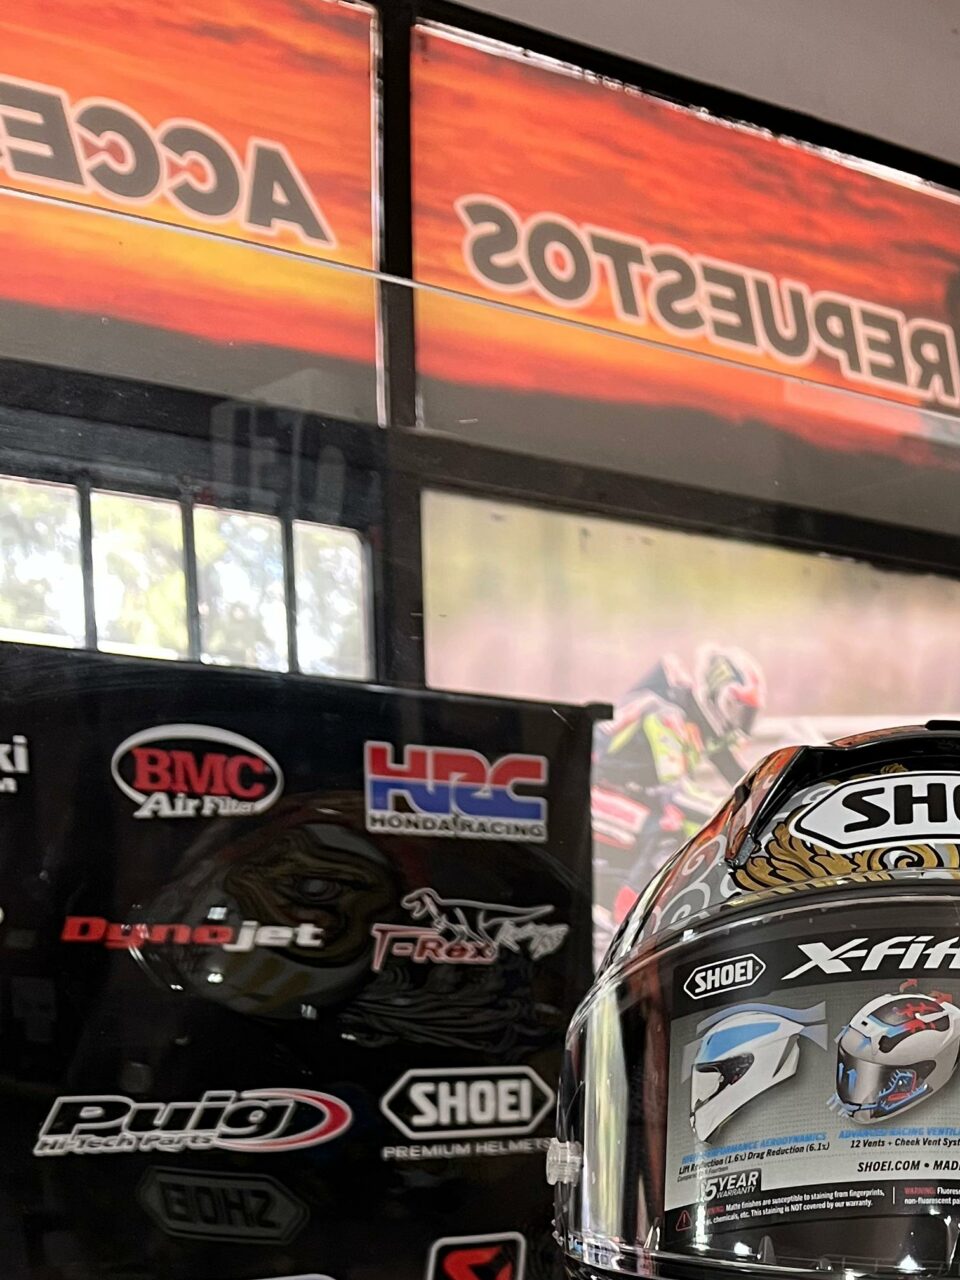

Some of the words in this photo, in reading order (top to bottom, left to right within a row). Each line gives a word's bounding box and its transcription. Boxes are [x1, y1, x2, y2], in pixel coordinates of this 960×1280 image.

[132, 747, 267, 798] BMC
[364, 741, 548, 822] HRC
[133, 792, 200, 818] Air
[201, 795, 259, 817] Filter
[369, 816, 453, 831] HONDA
[459, 820, 546, 838] RACING
[61, 915, 325, 952] Dynojet
[371, 923, 498, 972] T-Rex
[694, 959, 754, 994] SHOEI
[409, 1078, 533, 1127] SHOEI
[39, 1090, 296, 1142] Puig
[34, 1134, 139, 1155] Hi-Tech
[382, 1142, 471, 1161] PREMIUM
[748, 1149, 765, 1161] Drag
[766, 1144, 805, 1157] Reduction
[850, 1139, 861, 1149] 12
[863, 1138, 885, 1148] Vents
[894, 1138, 921, 1147] Cheek
[922, 1137, 942, 1147] Vent
[857, 1160, 921, 1173] SHOEI.COM
[716, 1185, 756, 1199] WARRANTY
[717, 1171, 759, 1191] YEAR
[726, 1203, 741, 1212] Matte
[762, 1199, 772, 1207] are
[772, 1195, 804, 1206] susceptible
[804, 1193, 811, 1201] to
[811, 1192, 834, 1202] staining
[834, 1190, 849, 1199] from
[849, 1188, 885, 1199] fingerprints,
[740, 1211, 750, 1220] etc.
[751, 1209, 762, 1218] This
[762, 1207, 784, 1217] staining
[790, 1204, 804, 1212] NOT
[803, 1202, 826, 1211] covered
[826, 1202, 834, 1210] by
[834, 1200, 845, 1208] our
[845, 1198, 873, 1209] warranty.
